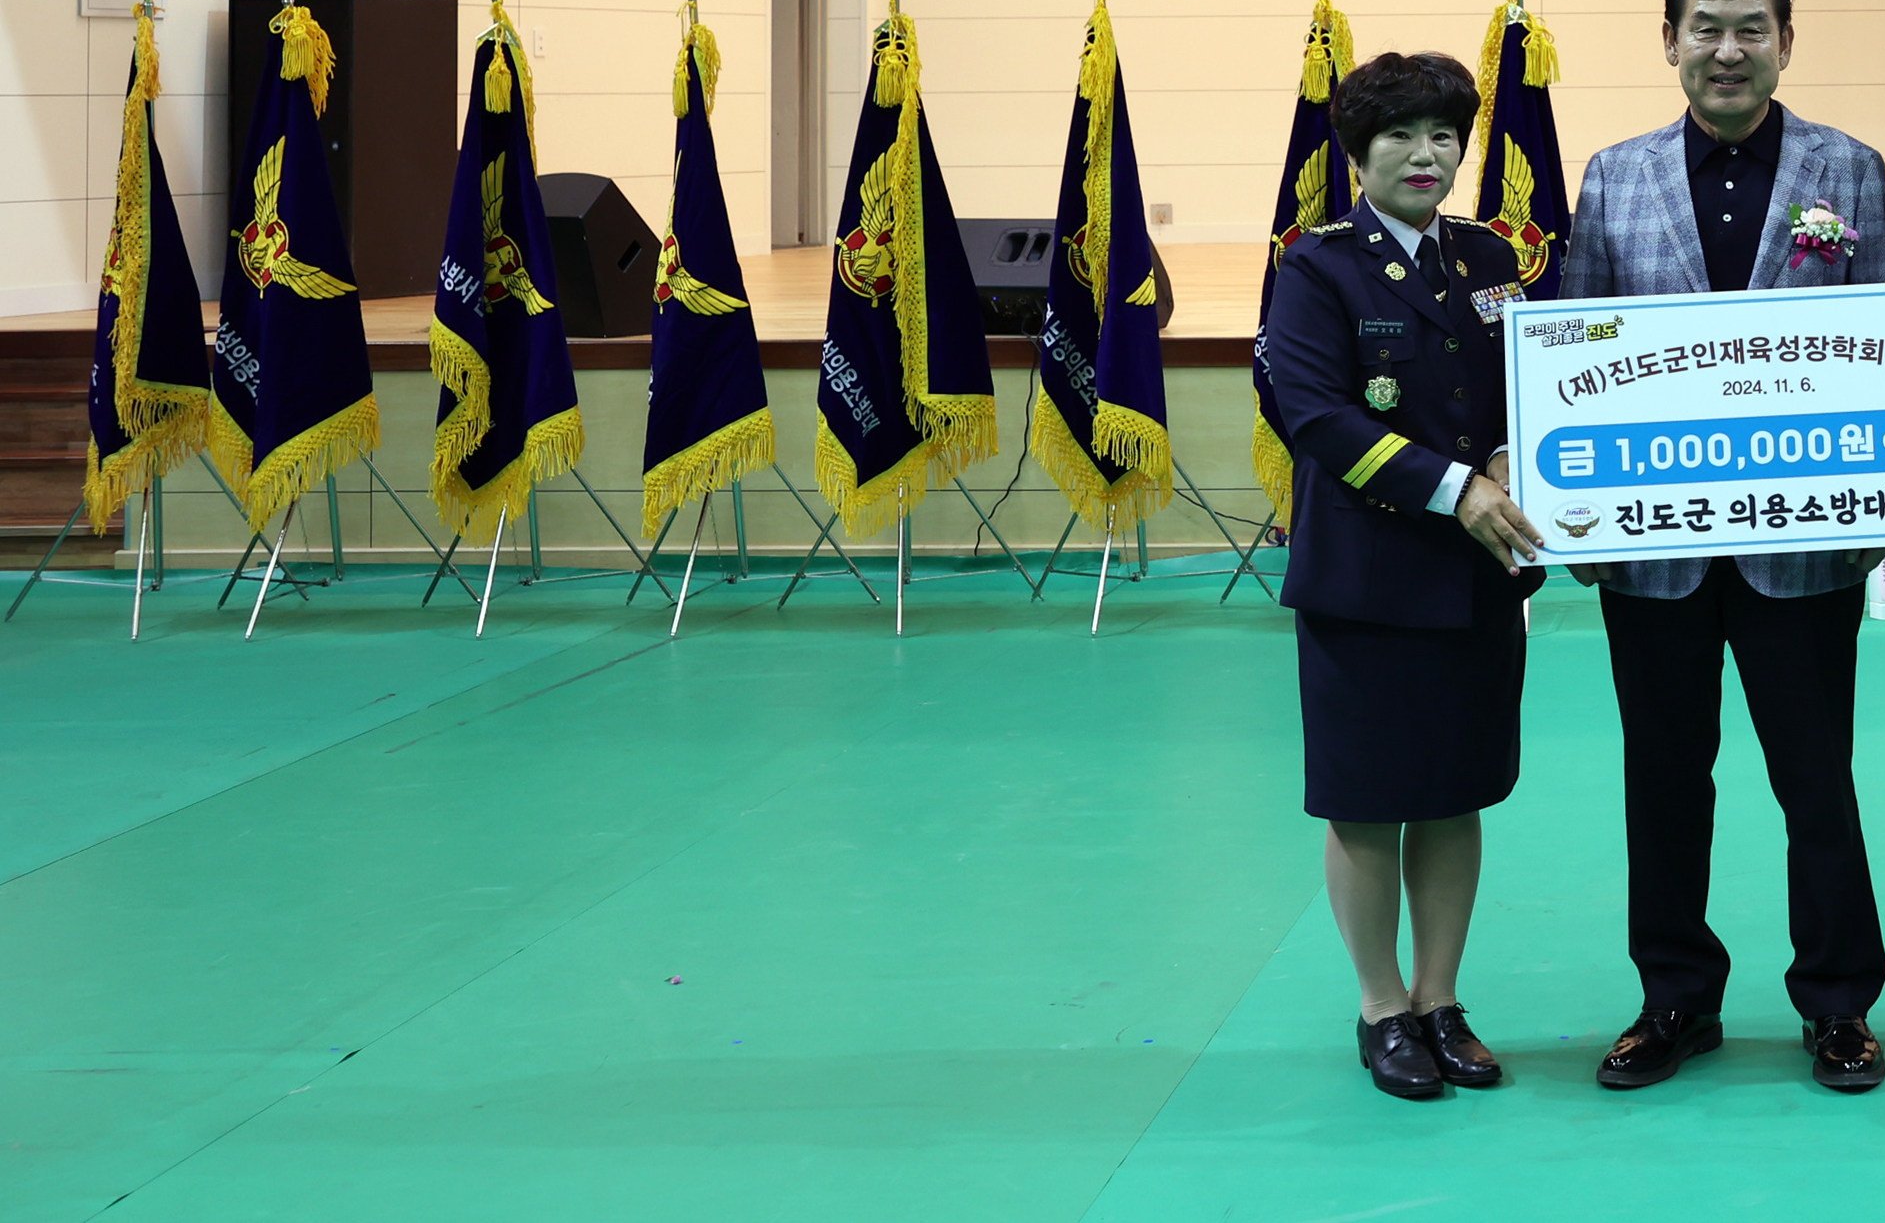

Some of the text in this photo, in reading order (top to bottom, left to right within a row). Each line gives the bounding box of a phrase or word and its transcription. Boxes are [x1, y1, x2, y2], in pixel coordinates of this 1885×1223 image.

[1586, 322, 1618, 341] 진도
[1722, 377, 1816, 396] 2024. 11. 6.
[1558, 438, 1596, 477] 금
[1615, 498, 1716, 536] 진도군
